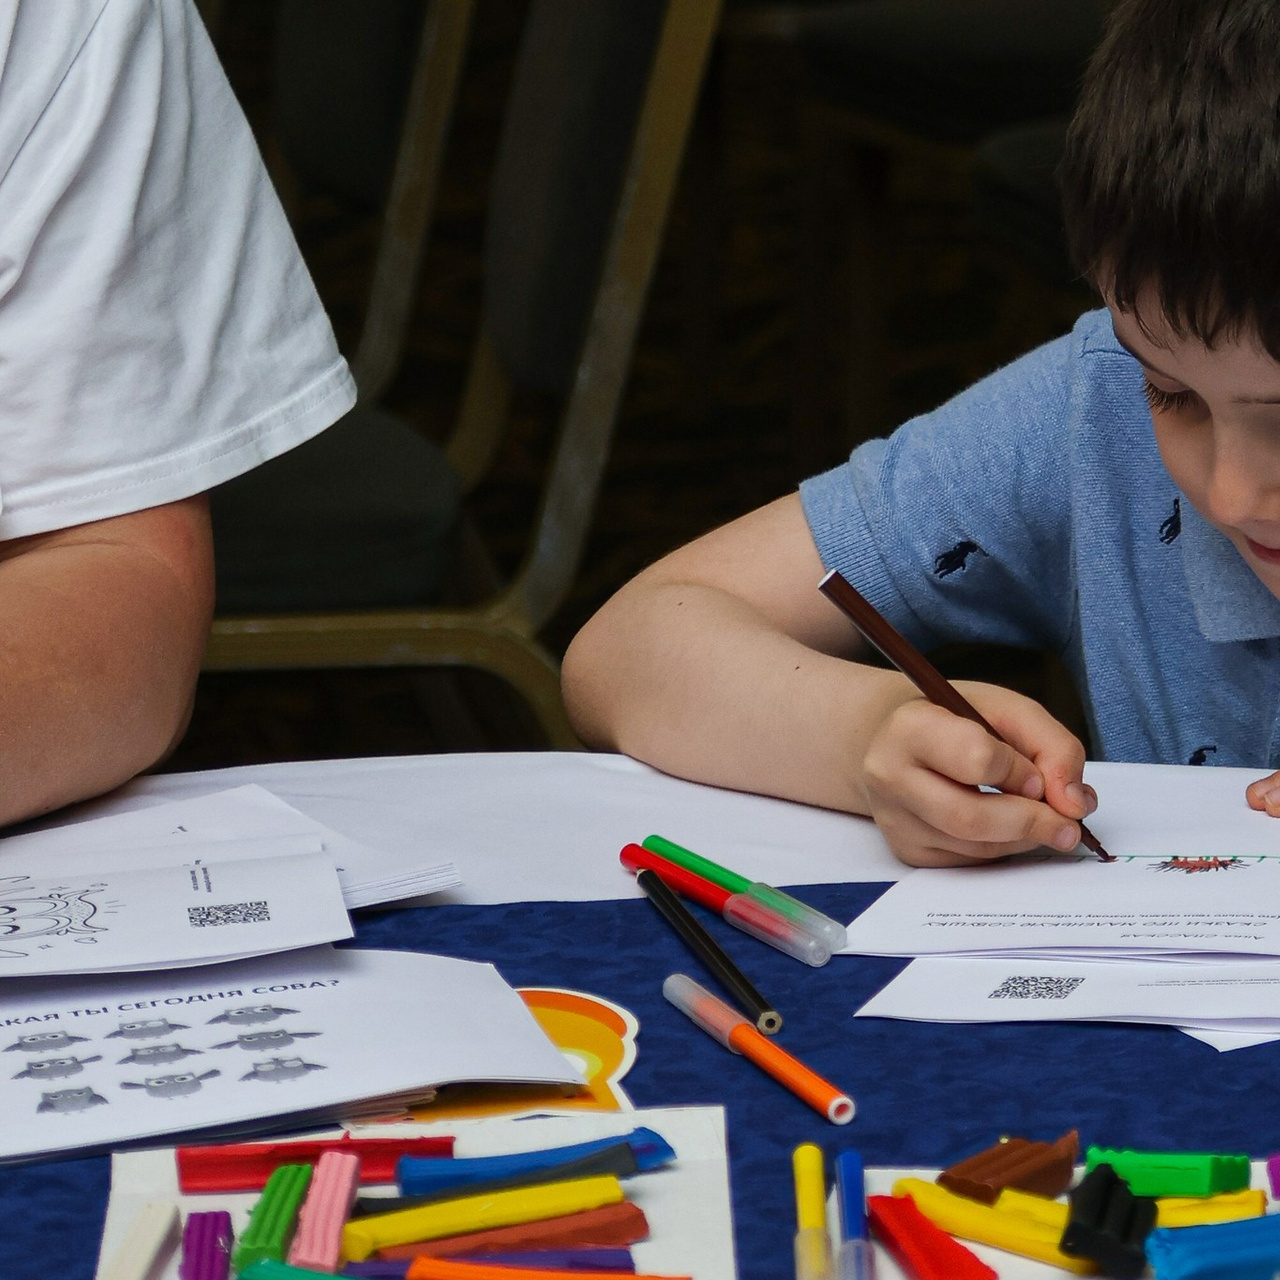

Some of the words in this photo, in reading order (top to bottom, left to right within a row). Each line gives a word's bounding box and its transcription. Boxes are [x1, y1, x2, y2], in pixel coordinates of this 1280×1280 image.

[67, 1006, 109, 1018] ТЫ
[117, 989, 244, 1012] СЕГОДНЯ
[251, 978, 341, 995] СОВА?
